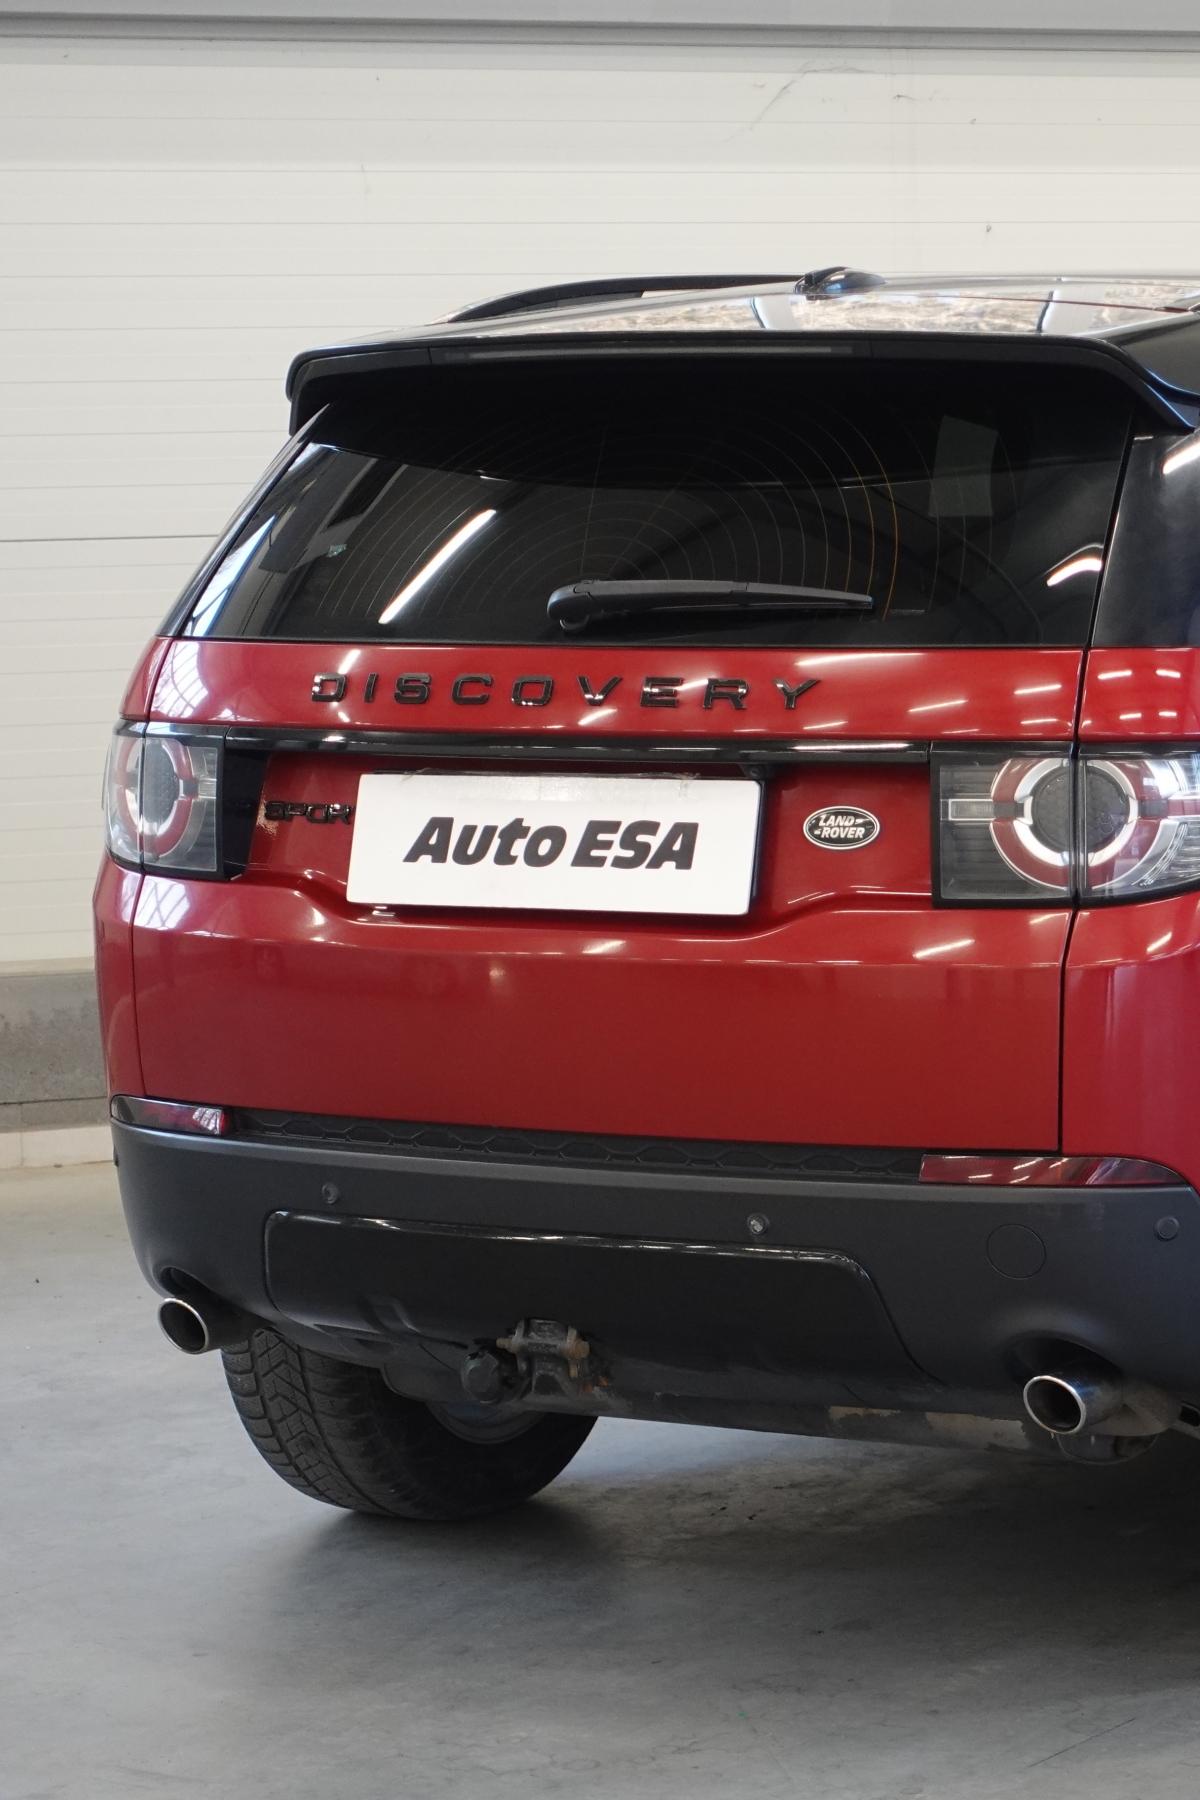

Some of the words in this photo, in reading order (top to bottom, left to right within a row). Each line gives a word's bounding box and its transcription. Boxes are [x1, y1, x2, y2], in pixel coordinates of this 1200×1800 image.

[311, 672, 821, 710] DISCOVERY
[264, 801, 352, 825] SPOR
[818, 814, 856, 827] LAND
[402, 816, 567, 867] Auto
[570, 820, 699, 870] ESA
[820, 827, 866, 839] ROVER
